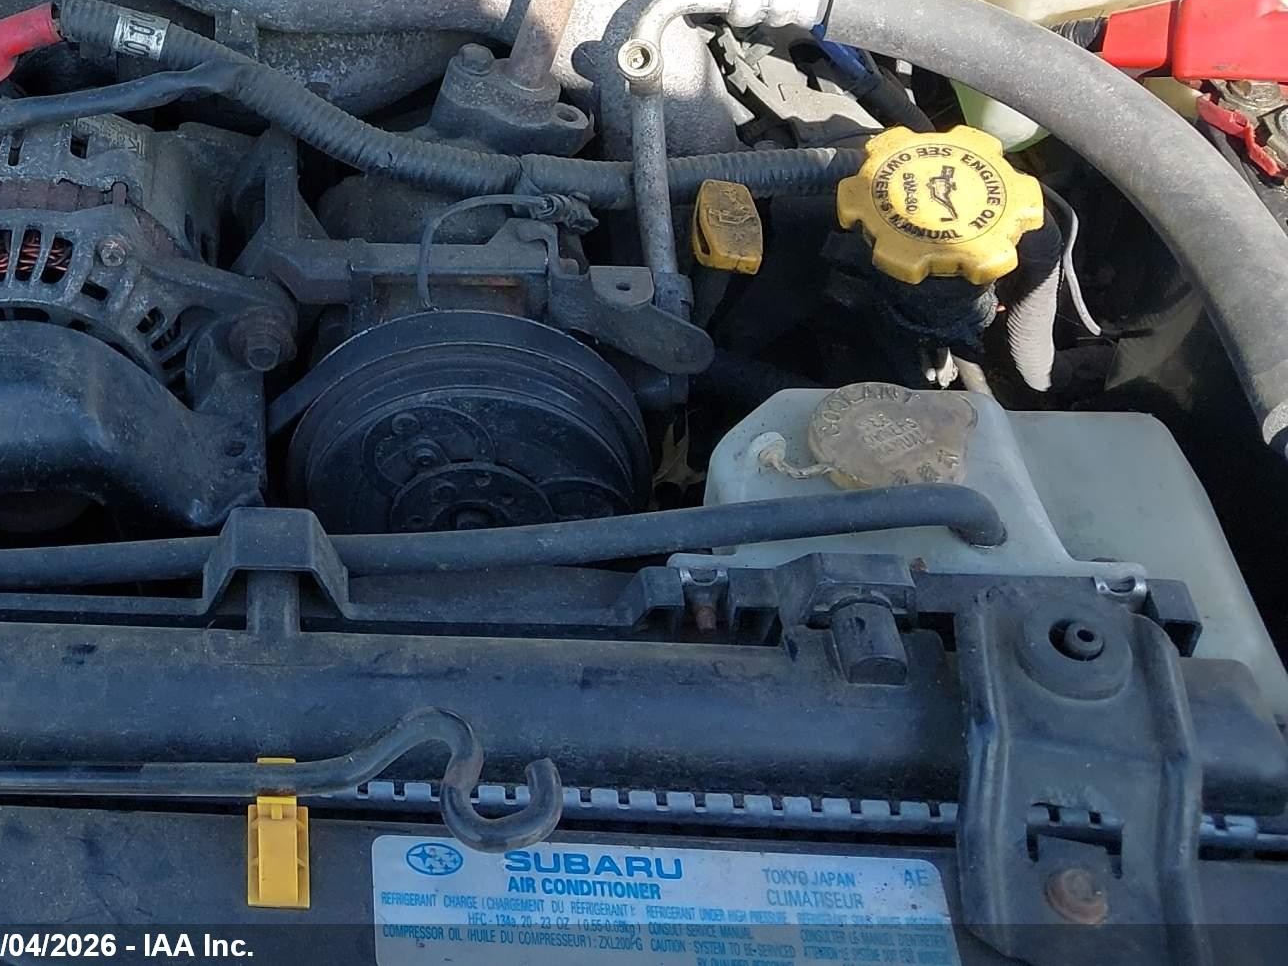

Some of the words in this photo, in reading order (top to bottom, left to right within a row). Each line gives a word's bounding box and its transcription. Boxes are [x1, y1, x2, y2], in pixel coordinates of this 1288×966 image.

[916, 145, 953, 158] SEE
[961, 153, 1004, 206] ENGINE
[890, 214, 963, 241] MANUAL
[968, 209, 997, 230] OIL
[504, 850, 682, 880] SUBARU
[763, 868, 810, 884] TOKYO
[812, 871, 857, 885] JAPAN
[508, 876, 537, 894] AIR
[542, 879, 662, 900] CONDITIONER
[381, 891, 437, 907] REFRIGERANT
[443, 894, 477, 909] CHARGE
[551, 900, 565, 914] DU
[766, 889, 864, 909] CLIMATISEUR
[468, 913, 486, 926] HFC
[382, 924, 444, 939] COMPRESSOR
[448, 927, 463, 941] OIL
[500, 930, 514, 944] DU
